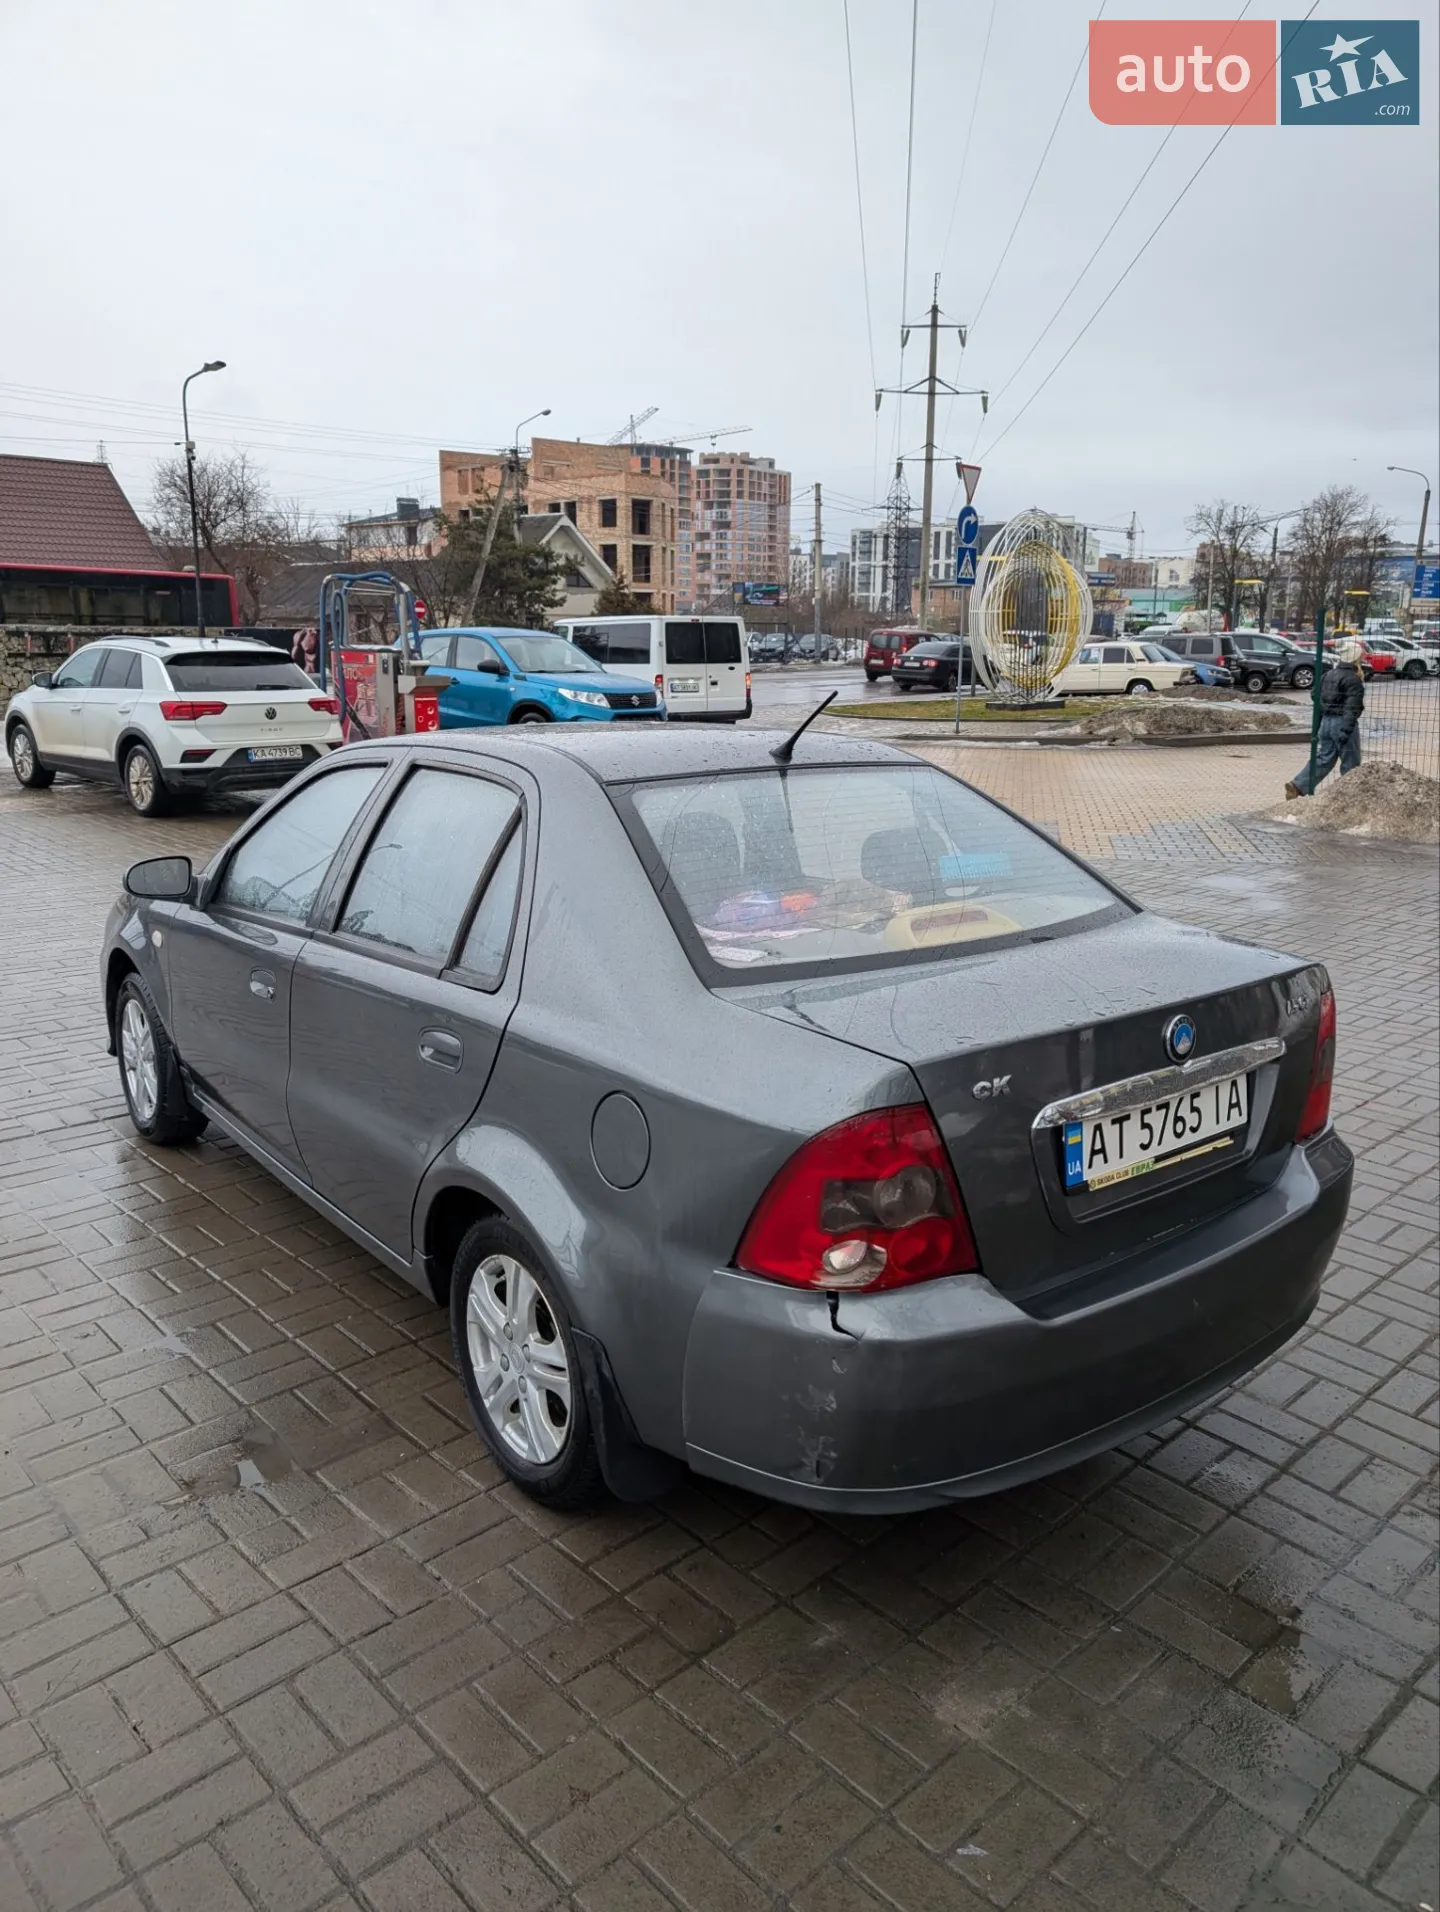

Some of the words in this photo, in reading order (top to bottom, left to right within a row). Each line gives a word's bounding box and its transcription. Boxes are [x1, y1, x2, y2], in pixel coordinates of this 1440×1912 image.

[268, 748, 288, 757] 4739
[973, 1075, 1012, 1099] CK
[1088, 1114, 1131, 1169] AT
[1139, 1091, 1202, 1151] 5765
[1215, 1079, 1242, 1125] IA
[1067, 1160, 1082, 1176] UA
